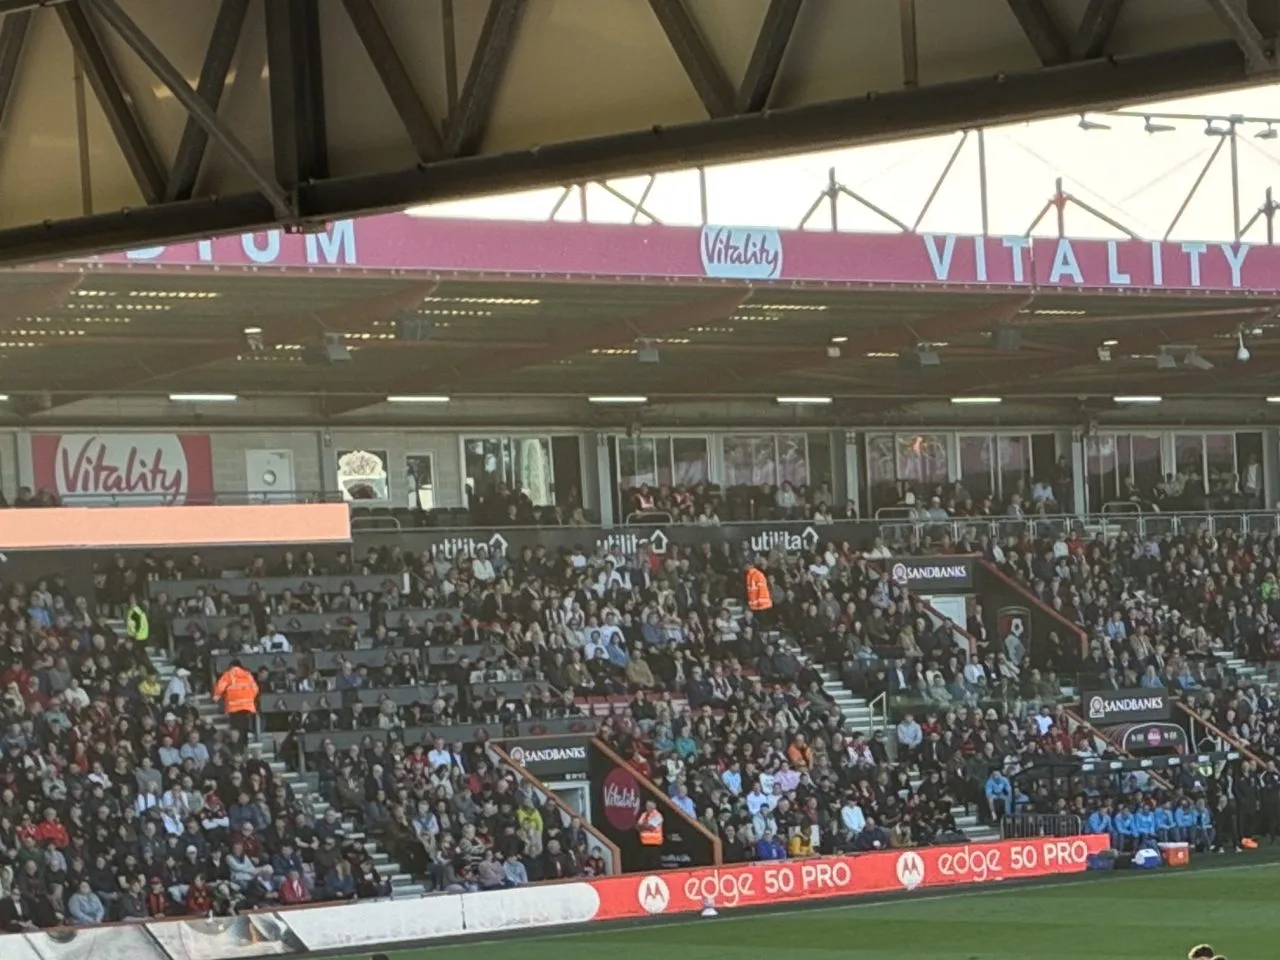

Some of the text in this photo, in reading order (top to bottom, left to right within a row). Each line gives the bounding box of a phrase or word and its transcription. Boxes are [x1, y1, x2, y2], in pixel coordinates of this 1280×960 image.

[126, 219, 357, 264] UM
[704, 226, 779, 277] Vitality
[923, 234, 1250, 287] VITALITY
[62, 437, 183, 505] Vitality
[907, 565, 967, 580] SANDBANKS
[1104, 697, 1163, 713] SANDBANKS
[525, 746, 586, 762] SANDBANKS
[604, 782, 641, 817] Vitality
[937, 845, 1002, 882] edge
[1010, 845, 1037, 870] 50
[1043, 840, 1088, 866] PRO
[685, 868, 755, 908] edge
[764, 868, 794, 894] 50
[802, 862, 851, 890] PRO
